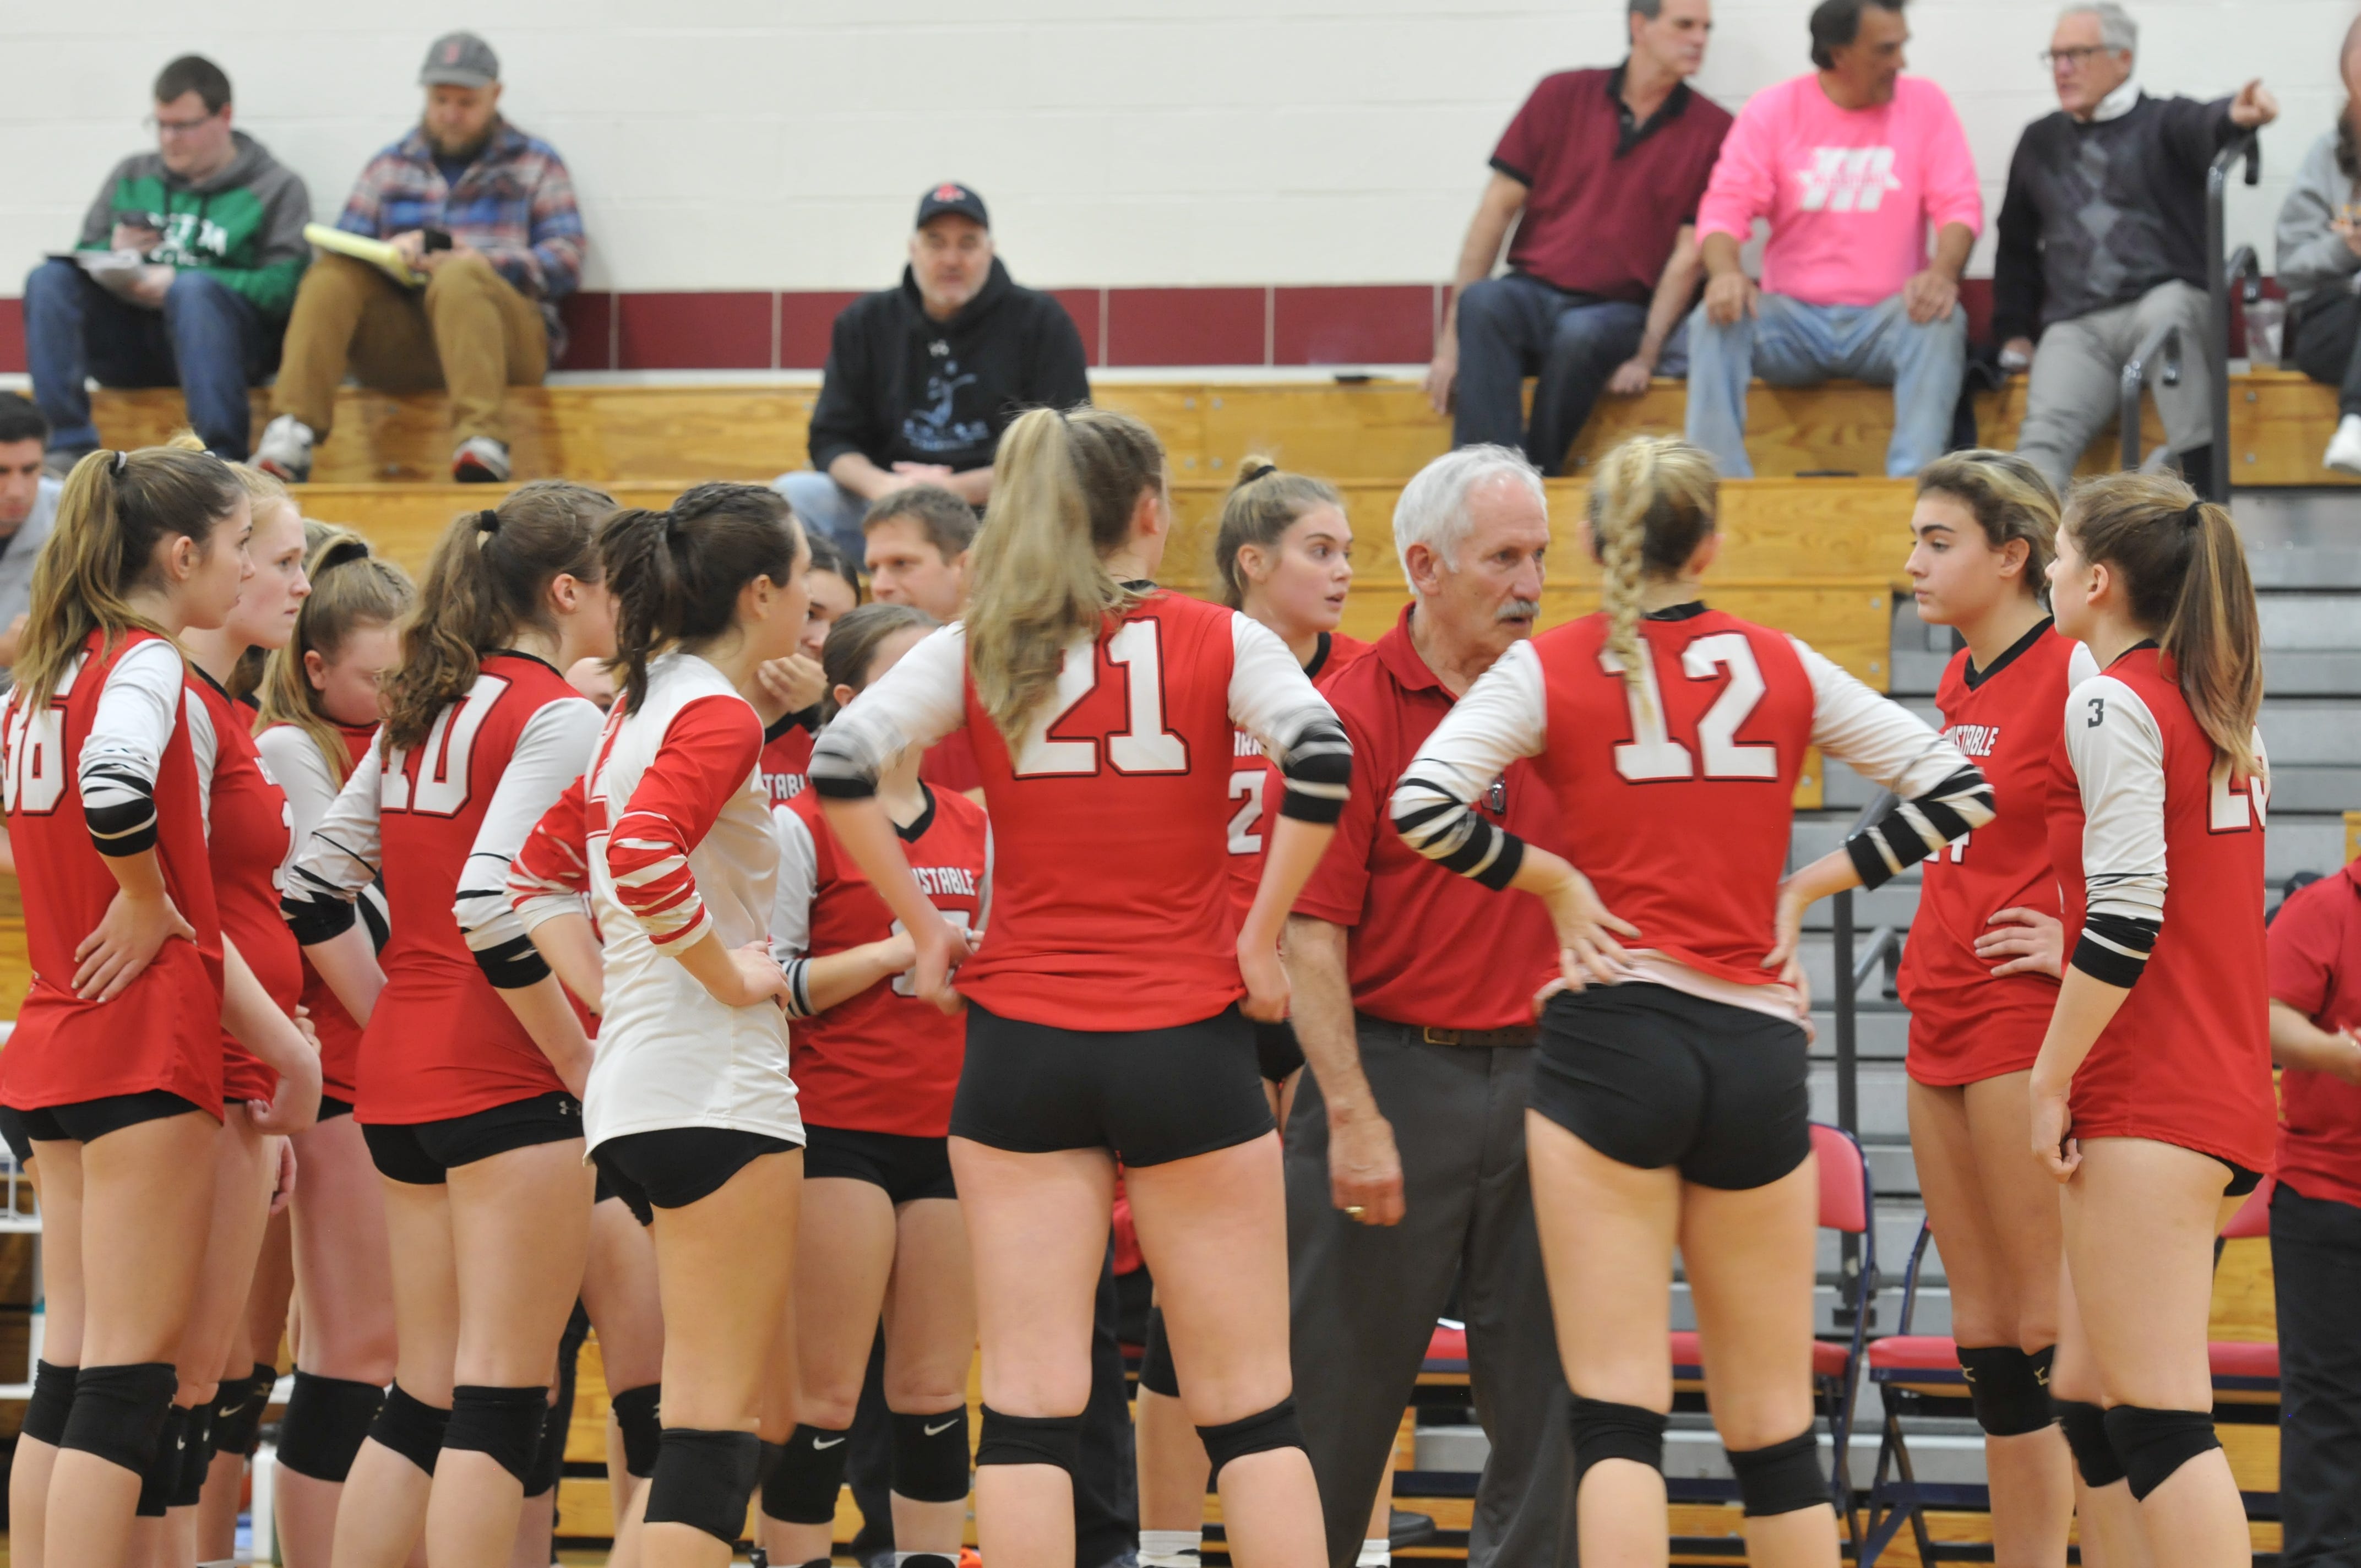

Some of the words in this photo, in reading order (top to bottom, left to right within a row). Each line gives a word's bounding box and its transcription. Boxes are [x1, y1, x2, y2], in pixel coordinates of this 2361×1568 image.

[1014, 617, 1190, 780] 21
[1598, 630, 1778, 784] 12
[2087, 698, 2104, 728] 3
